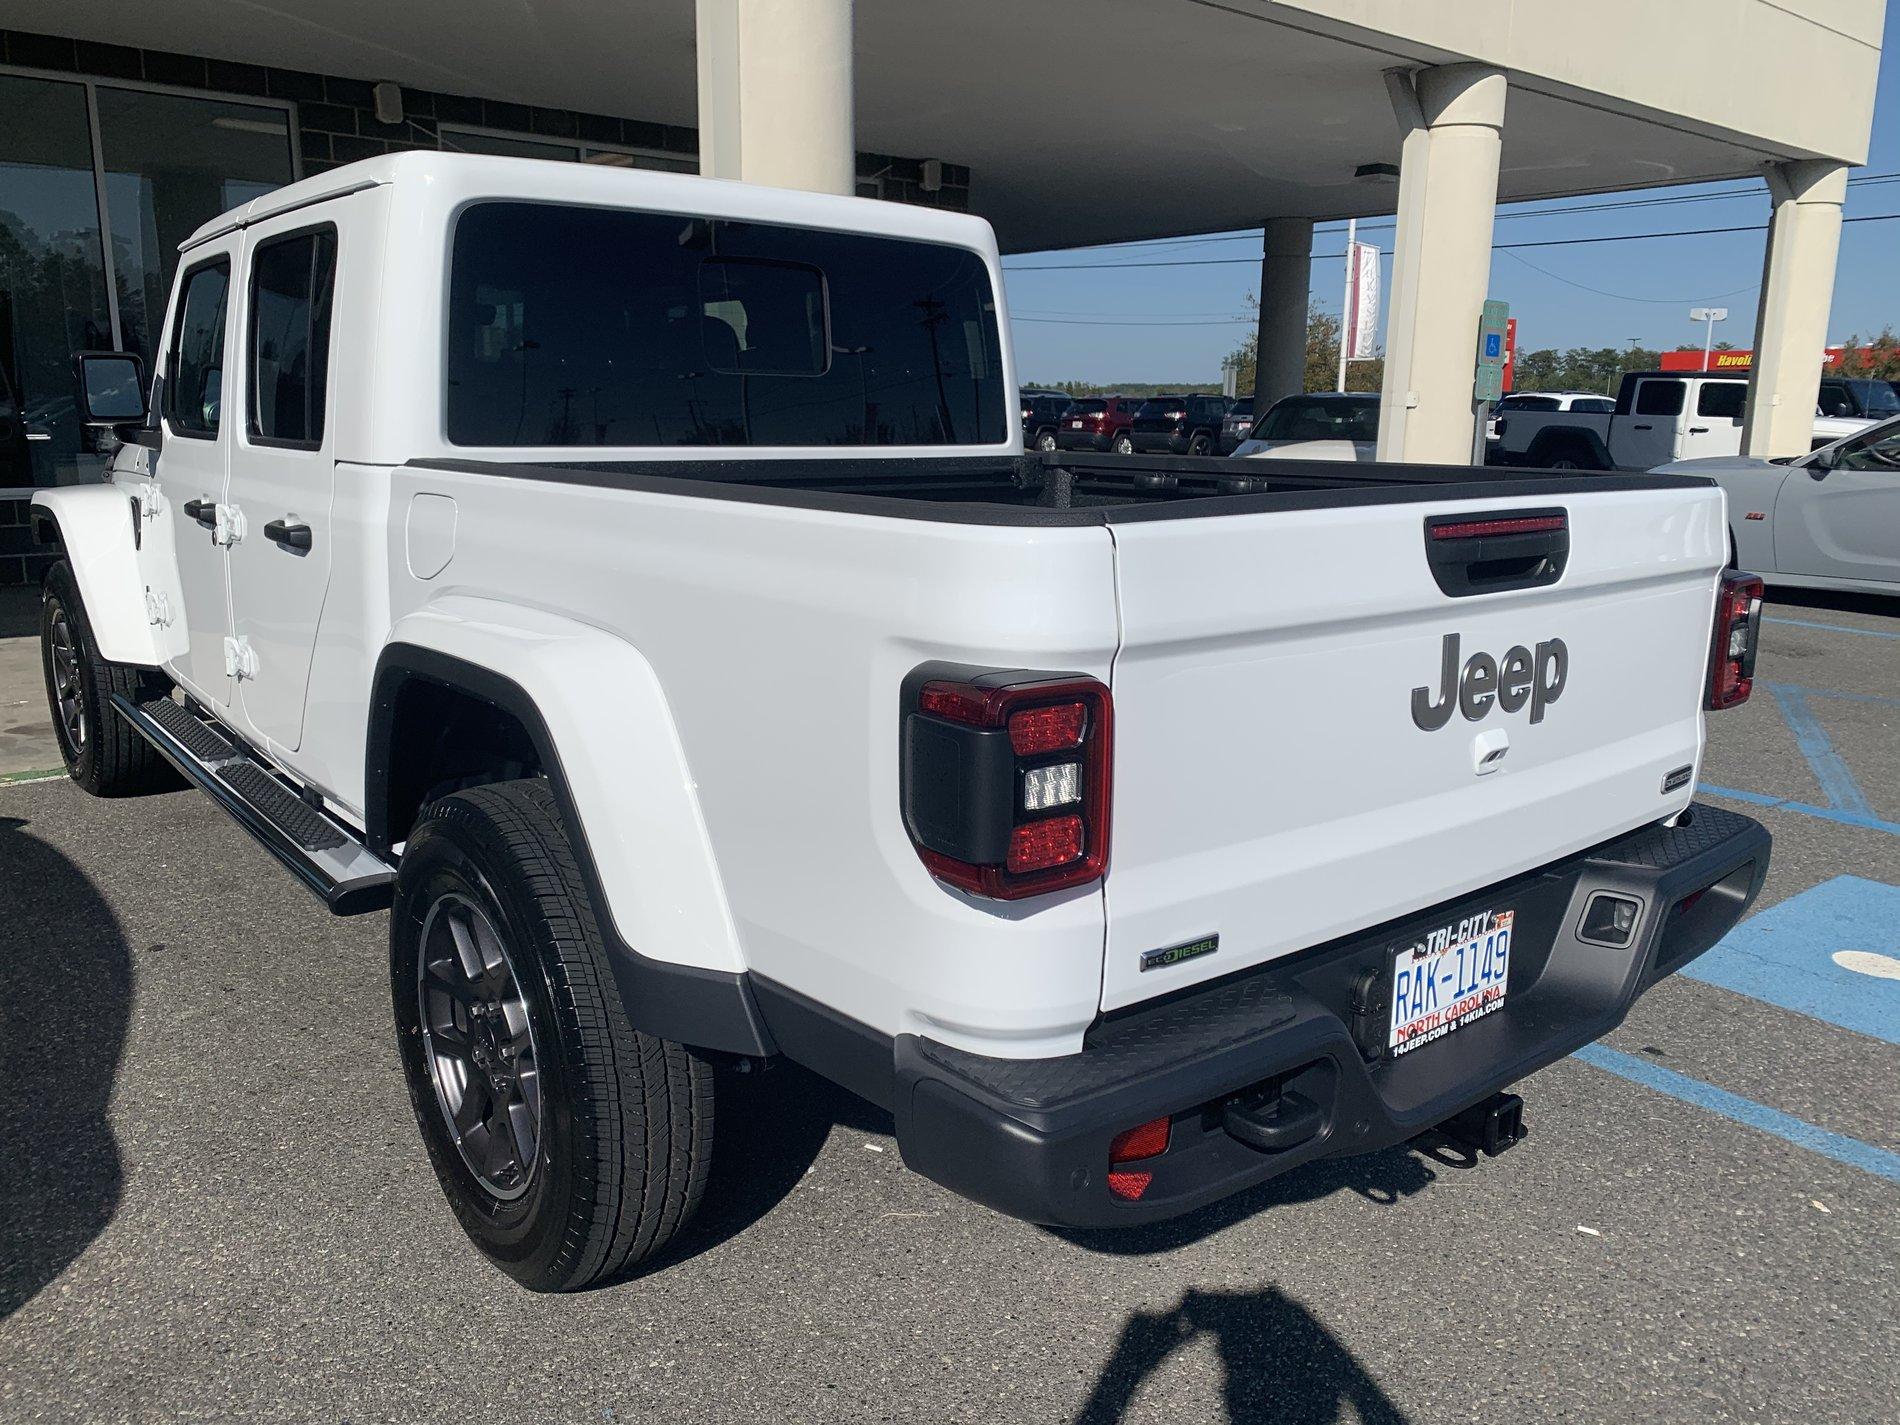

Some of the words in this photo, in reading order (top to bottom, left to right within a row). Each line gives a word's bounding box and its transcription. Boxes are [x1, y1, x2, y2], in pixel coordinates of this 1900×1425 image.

[1717, 354, 1753, 366] Havoli
[1411, 633, 1568, 732] Jeep
[1426, 910, 1493, 955] TRI-CITY
[1395, 930, 1509, 1025] RAK-1149
[1393, 1023, 1449, 1058] 14JEEP.COM
[1450, 1020, 1457, 1032] &
[1460, 997, 1505, 1027] 14KIA.COM
[1397, 1012, 1440, 1044] NORTH
